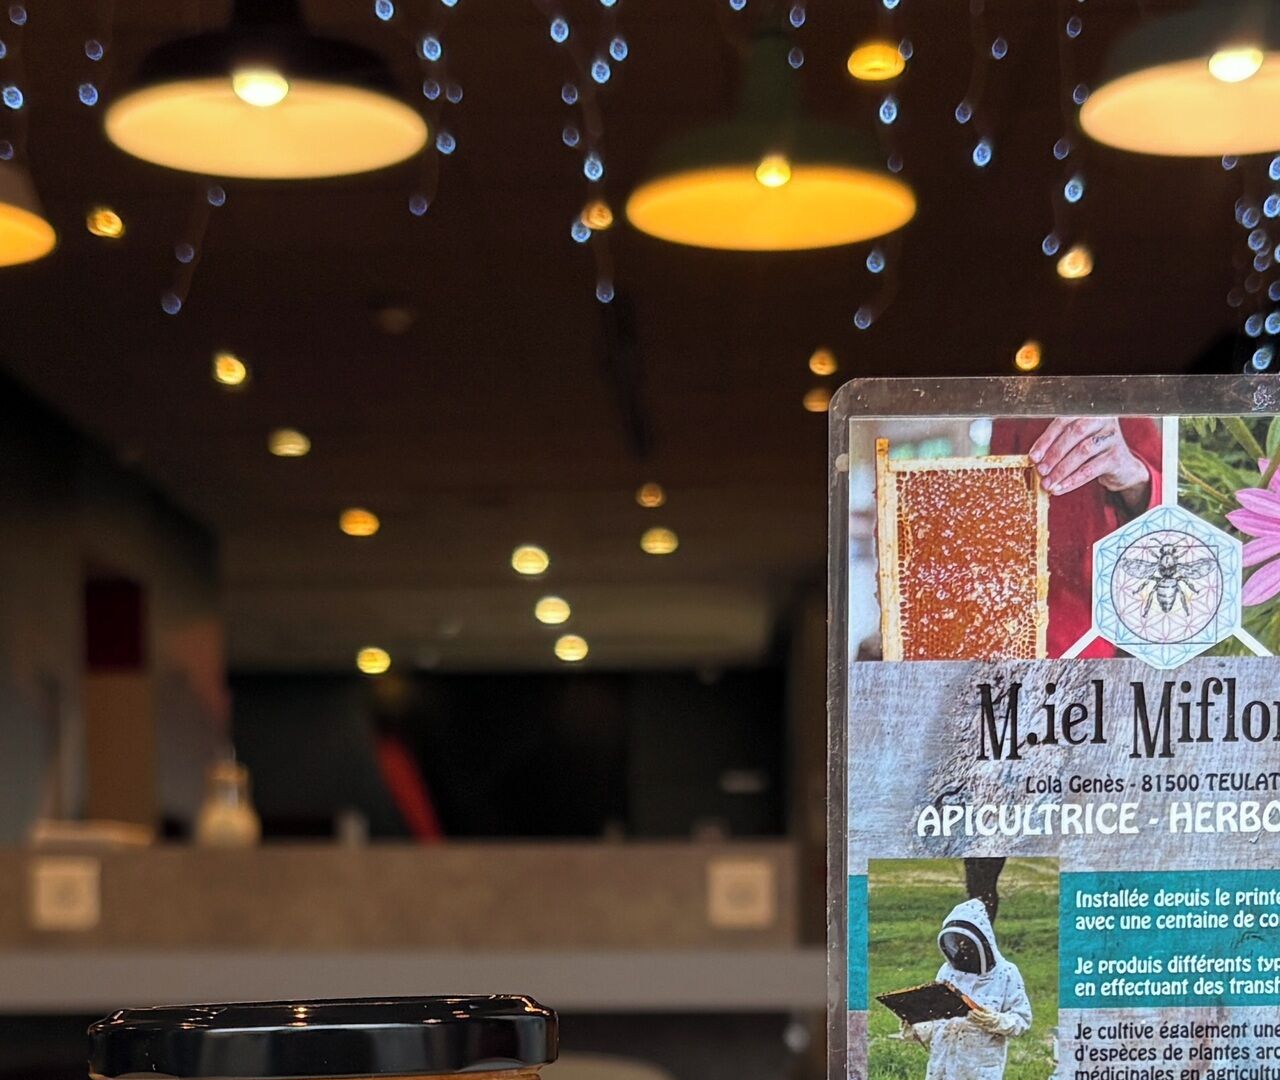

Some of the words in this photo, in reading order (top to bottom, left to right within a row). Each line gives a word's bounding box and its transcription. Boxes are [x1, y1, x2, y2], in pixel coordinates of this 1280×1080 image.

[976, 679, 1107, 762] M.iel
[1026, 774, 1062, 794] Lola
[1070, 774, 1124, 794] Genès
[1142, 773, 1199, 793] 81500
[1206, 773, 1280, 792] TEULAT
[917, 801, 1139, 836] APICULTRICE
[1076, 888, 1149, 909] Installée
[1154, 888, 1210, 908] depuis
[1216, 888, 1230, 908] le
[1076, 911, 1114, 931] avec
[1121, 911, 1153, 930] une
[1158, 910, 1227, 929] centaine
[1234, 909, 1254, 929] de
[1075, 978, 1095, 997] en
[1100, 978, 1188, 996] effectuant
[1193, 977, 1224, 995] des
[1074, 1023, 1093, 1039] Je
[1098, 1023, 1154, 1039] cultive
[1160, 1022, 1248, 1038] également
[1075, 1044, 1156, 1061] d'espèces
[1163, 1044, 1183, 1060] de
[1189, 1043, 1250, 1060] plantes
